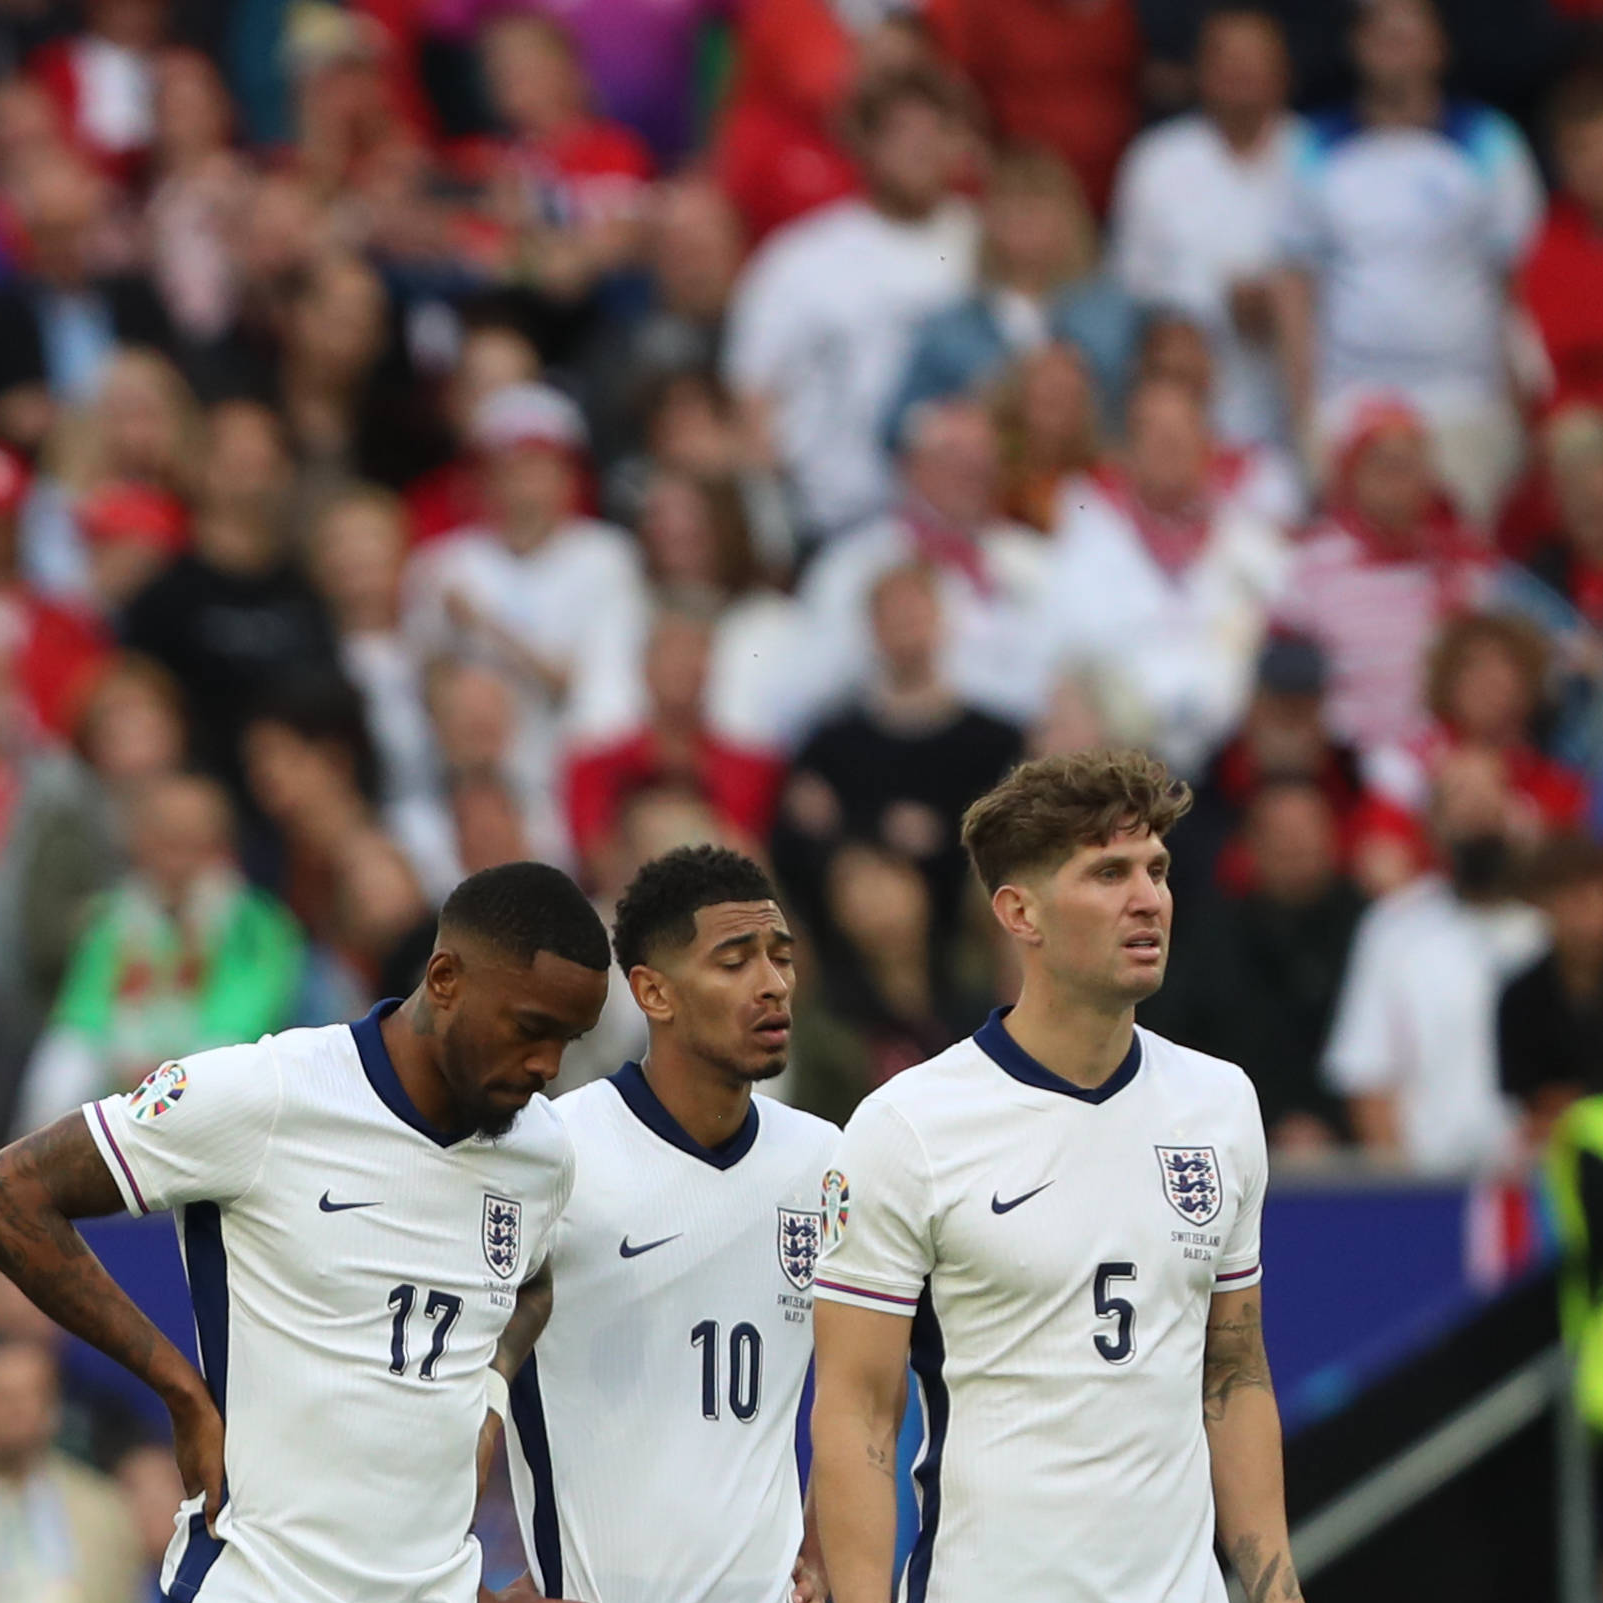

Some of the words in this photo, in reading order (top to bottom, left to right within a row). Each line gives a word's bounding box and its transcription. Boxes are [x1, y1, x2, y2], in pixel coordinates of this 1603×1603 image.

[388, 1284, 463, 1381] 17
[1093, 1262, 1138, 1365] 5
[691, 1320, 763, 1423] 10
